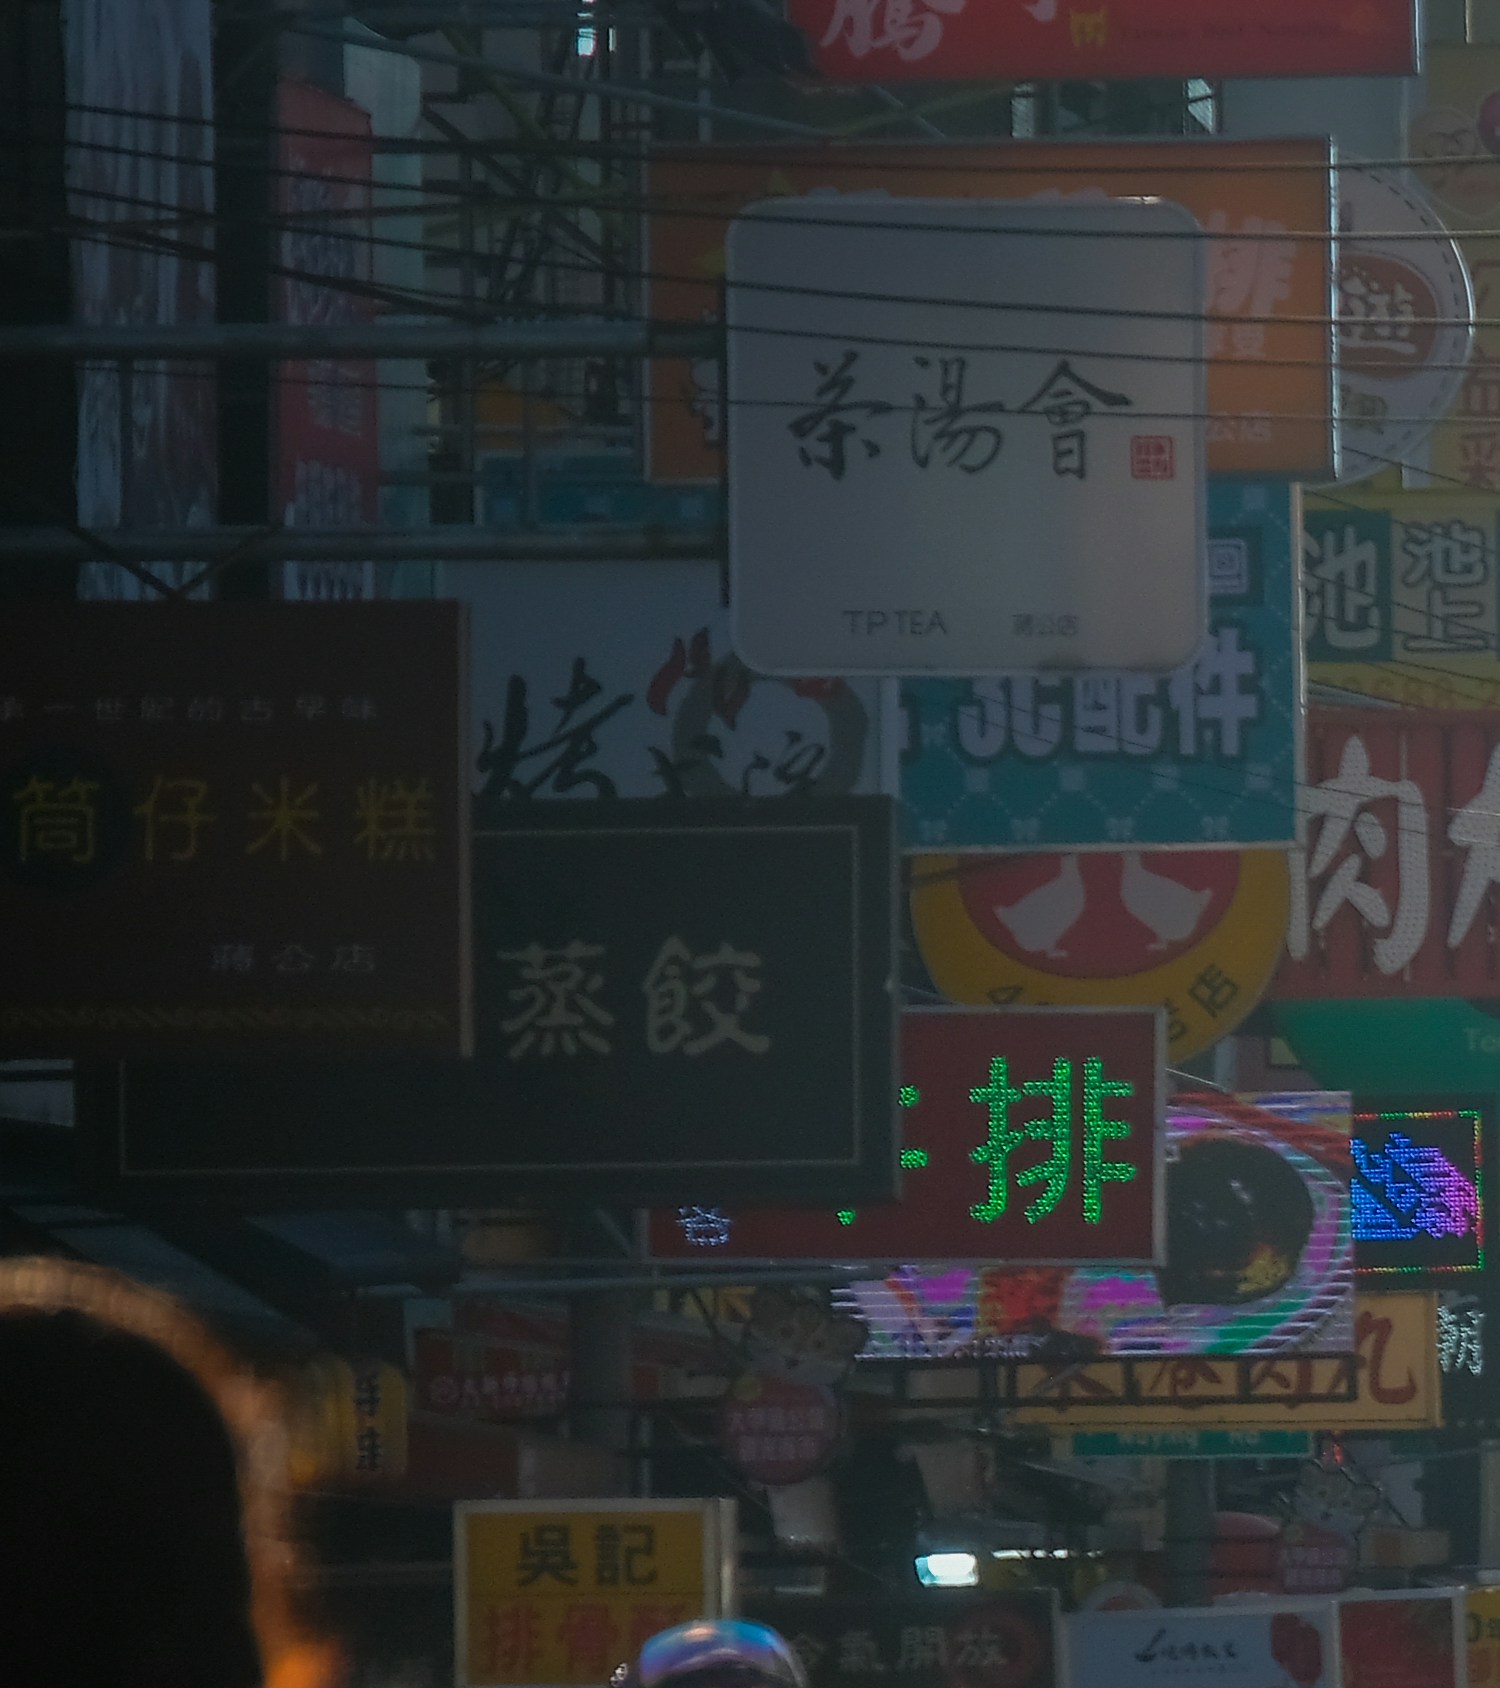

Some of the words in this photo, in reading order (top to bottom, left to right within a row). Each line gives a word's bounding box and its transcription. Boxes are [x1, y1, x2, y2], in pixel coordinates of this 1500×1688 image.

[788, 350, 1131, 482] 茶湯會
[14, 775, 438, 864] 筒仔米糕
[496, 934, 771, 1057] 蒸餃
[517, 1523, 659, 1588] 吳記
